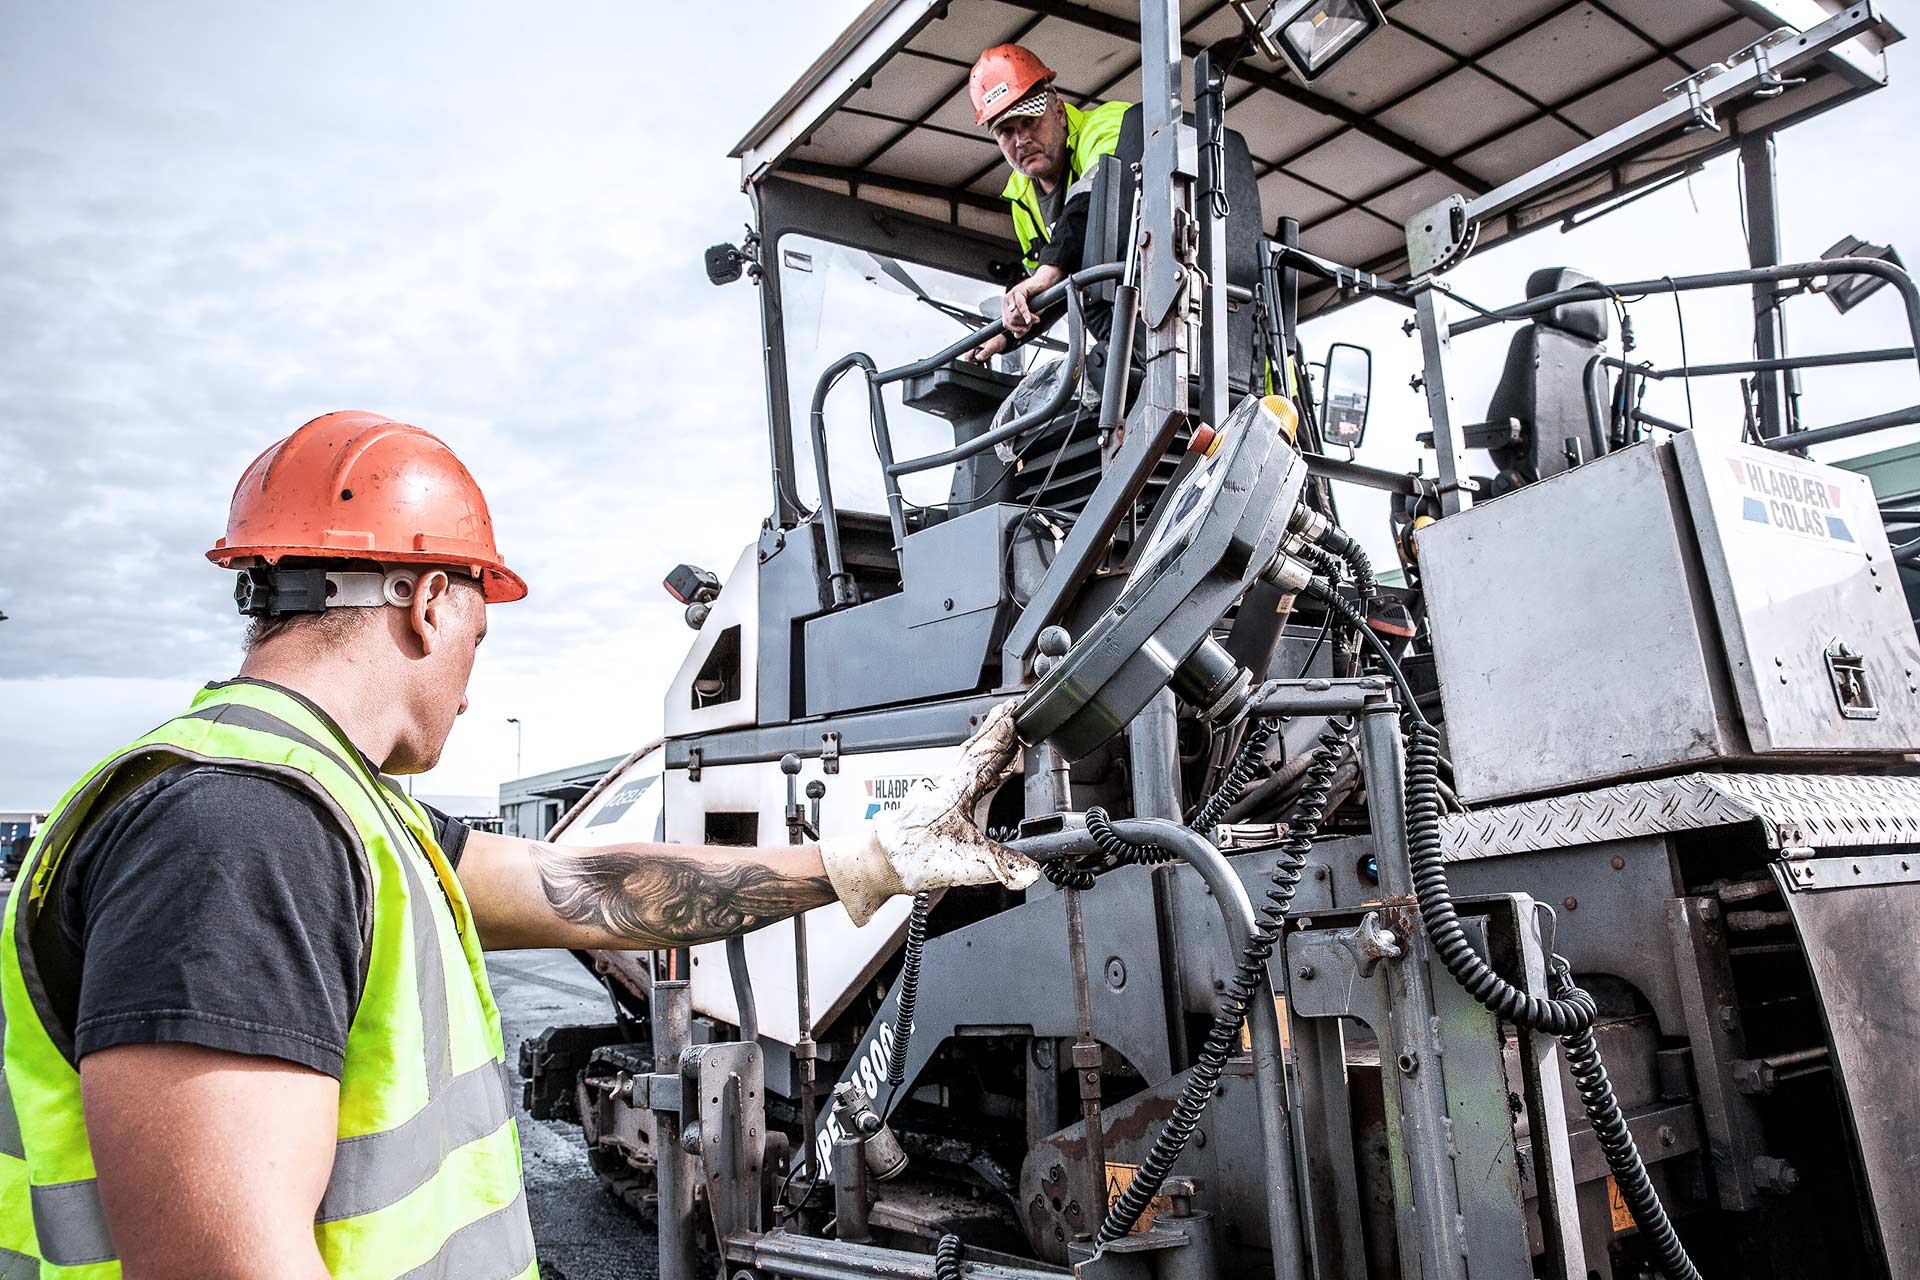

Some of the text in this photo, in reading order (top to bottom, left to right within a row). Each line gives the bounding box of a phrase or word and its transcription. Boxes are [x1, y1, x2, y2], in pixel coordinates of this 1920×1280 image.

[1746, 463, 1830, 509] HLAÐBÆR
[1770, 500, 1825, 537] COLAS
[875, 779, 917, 799] HLAÐB
